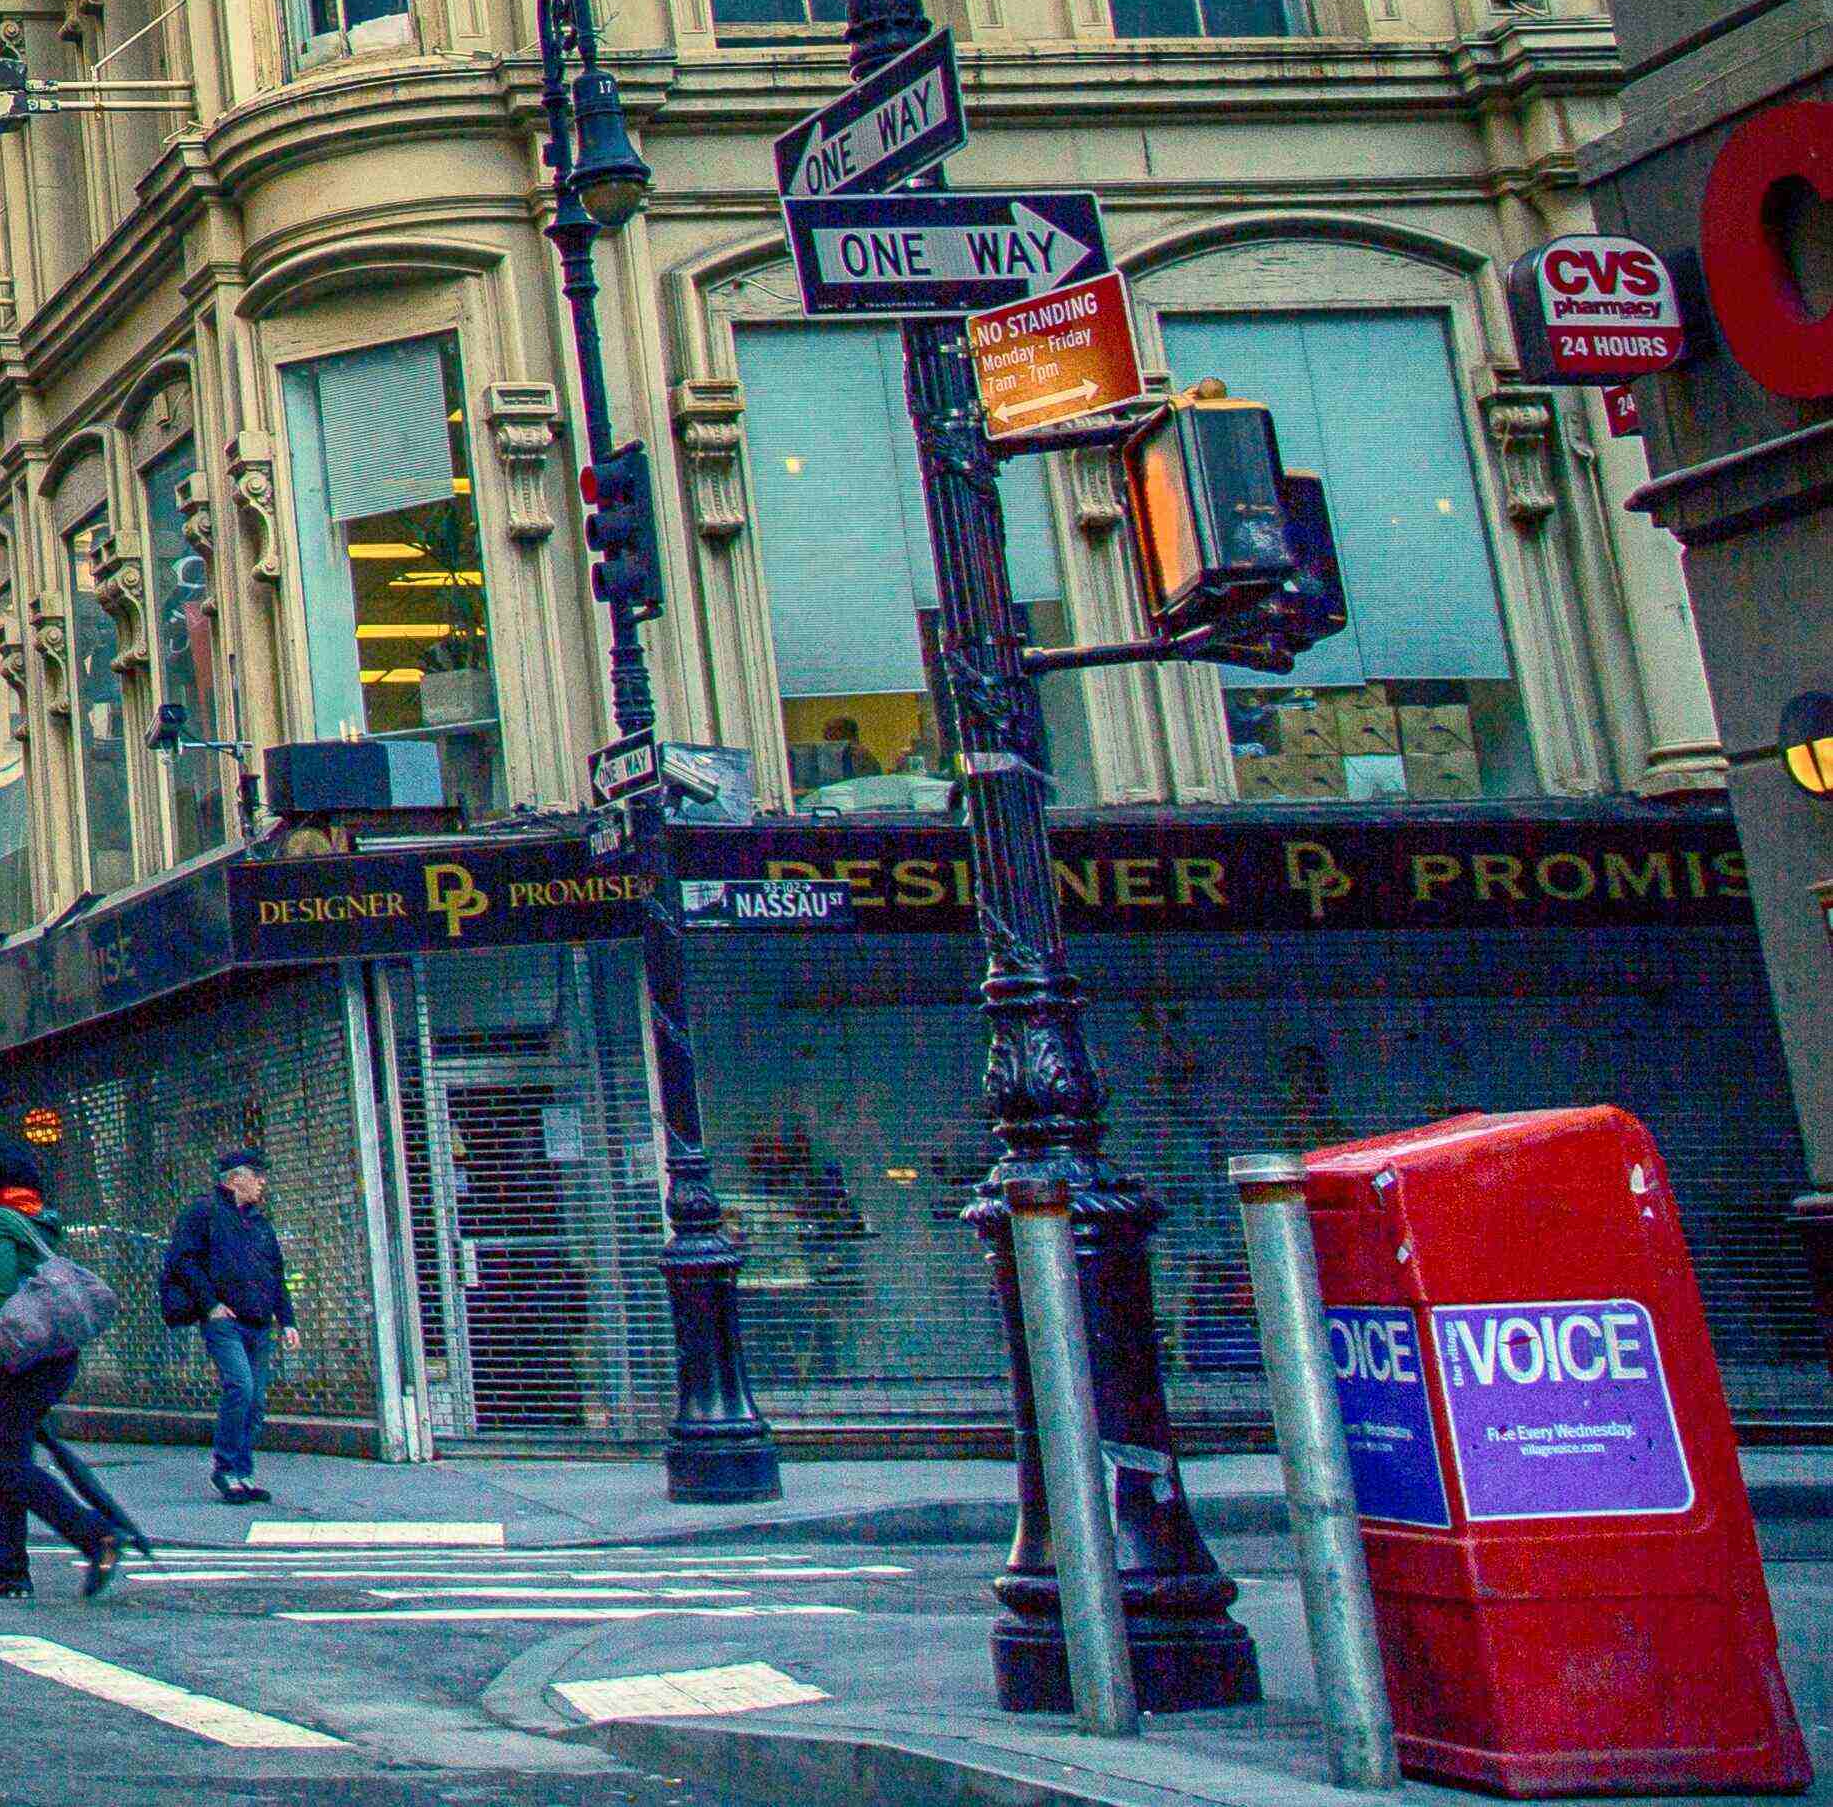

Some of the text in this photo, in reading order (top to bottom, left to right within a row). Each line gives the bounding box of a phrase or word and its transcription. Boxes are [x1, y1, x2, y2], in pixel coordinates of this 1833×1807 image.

[598, 80, 612, 94] 17
[805, 80, 932, 195] ONE WAY
[839, 230, 1056, 278] ONE WAY
[1544, 249, 1661, 296] CVS
[976, 292, 1098, 348] NO STANDING
[1553, 296, 1662, 320] pharmacy
[982, 344, 1035, 373] Monday
[1047, 327, 1092, 353] Friday
[1560, 336, 1668, 357] 24 HOURS
[986, 373, 1018, 394] 7am
[1028, 361, 1060, 384] 7pm
[736, 892, 829, 918] NASSAU
[829, 892, 844, 905] ST
[765, 857, 1228, 909] ESINER
[258, 891, 408, 927] DESIGNER
[1328, 1317, 1418, 1383] OICE
[1454, 1312, 1648, 1386] VOICE
[1486, 1422, 1637, 1443] Free Every Wednesday.
